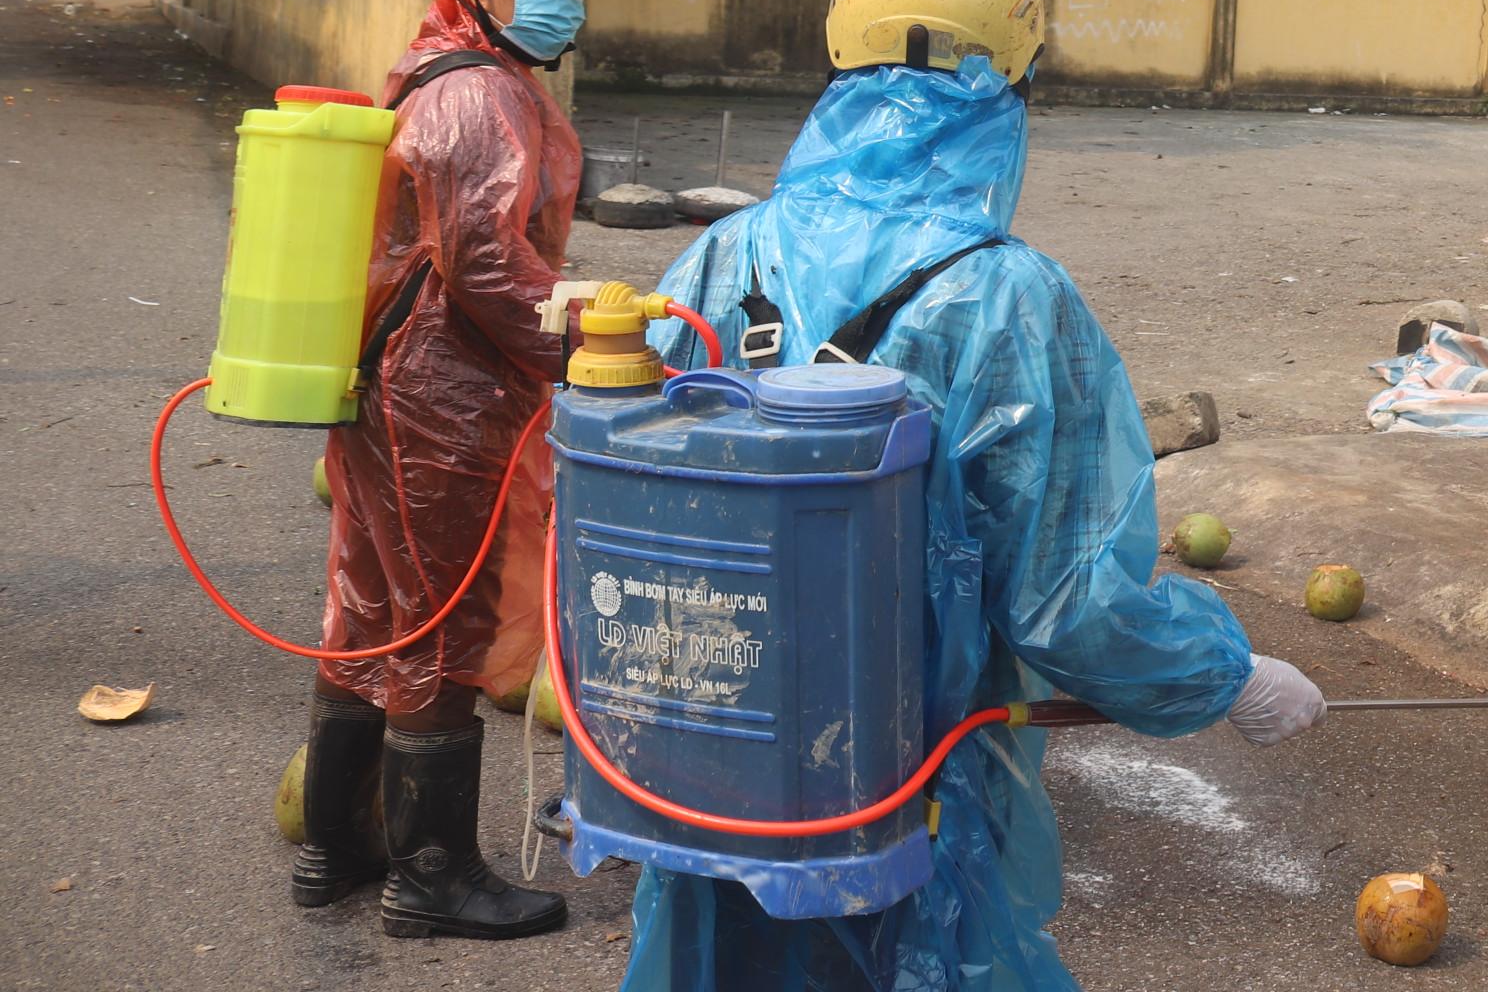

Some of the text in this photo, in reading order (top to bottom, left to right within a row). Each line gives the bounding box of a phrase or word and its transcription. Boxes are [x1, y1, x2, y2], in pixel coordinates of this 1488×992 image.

[624, 576, 644, 599] BÌNH
[646, 583, 666, 601] BƠM
[667, 587, 685, 603] TAY
[724, 593, 745, 613] LỰC
[747, 591, 767, 612] MỚI
[597, 617, 763, 676] LD VIỆT NHẬT
[626, 665, 645, 682] SIÊU
[660, 673, 680, 689] LỰC
[681, 677, 693, 689] LD
[699, 680, 714, 693] VN
[715, 682, 732, 695] 16L
